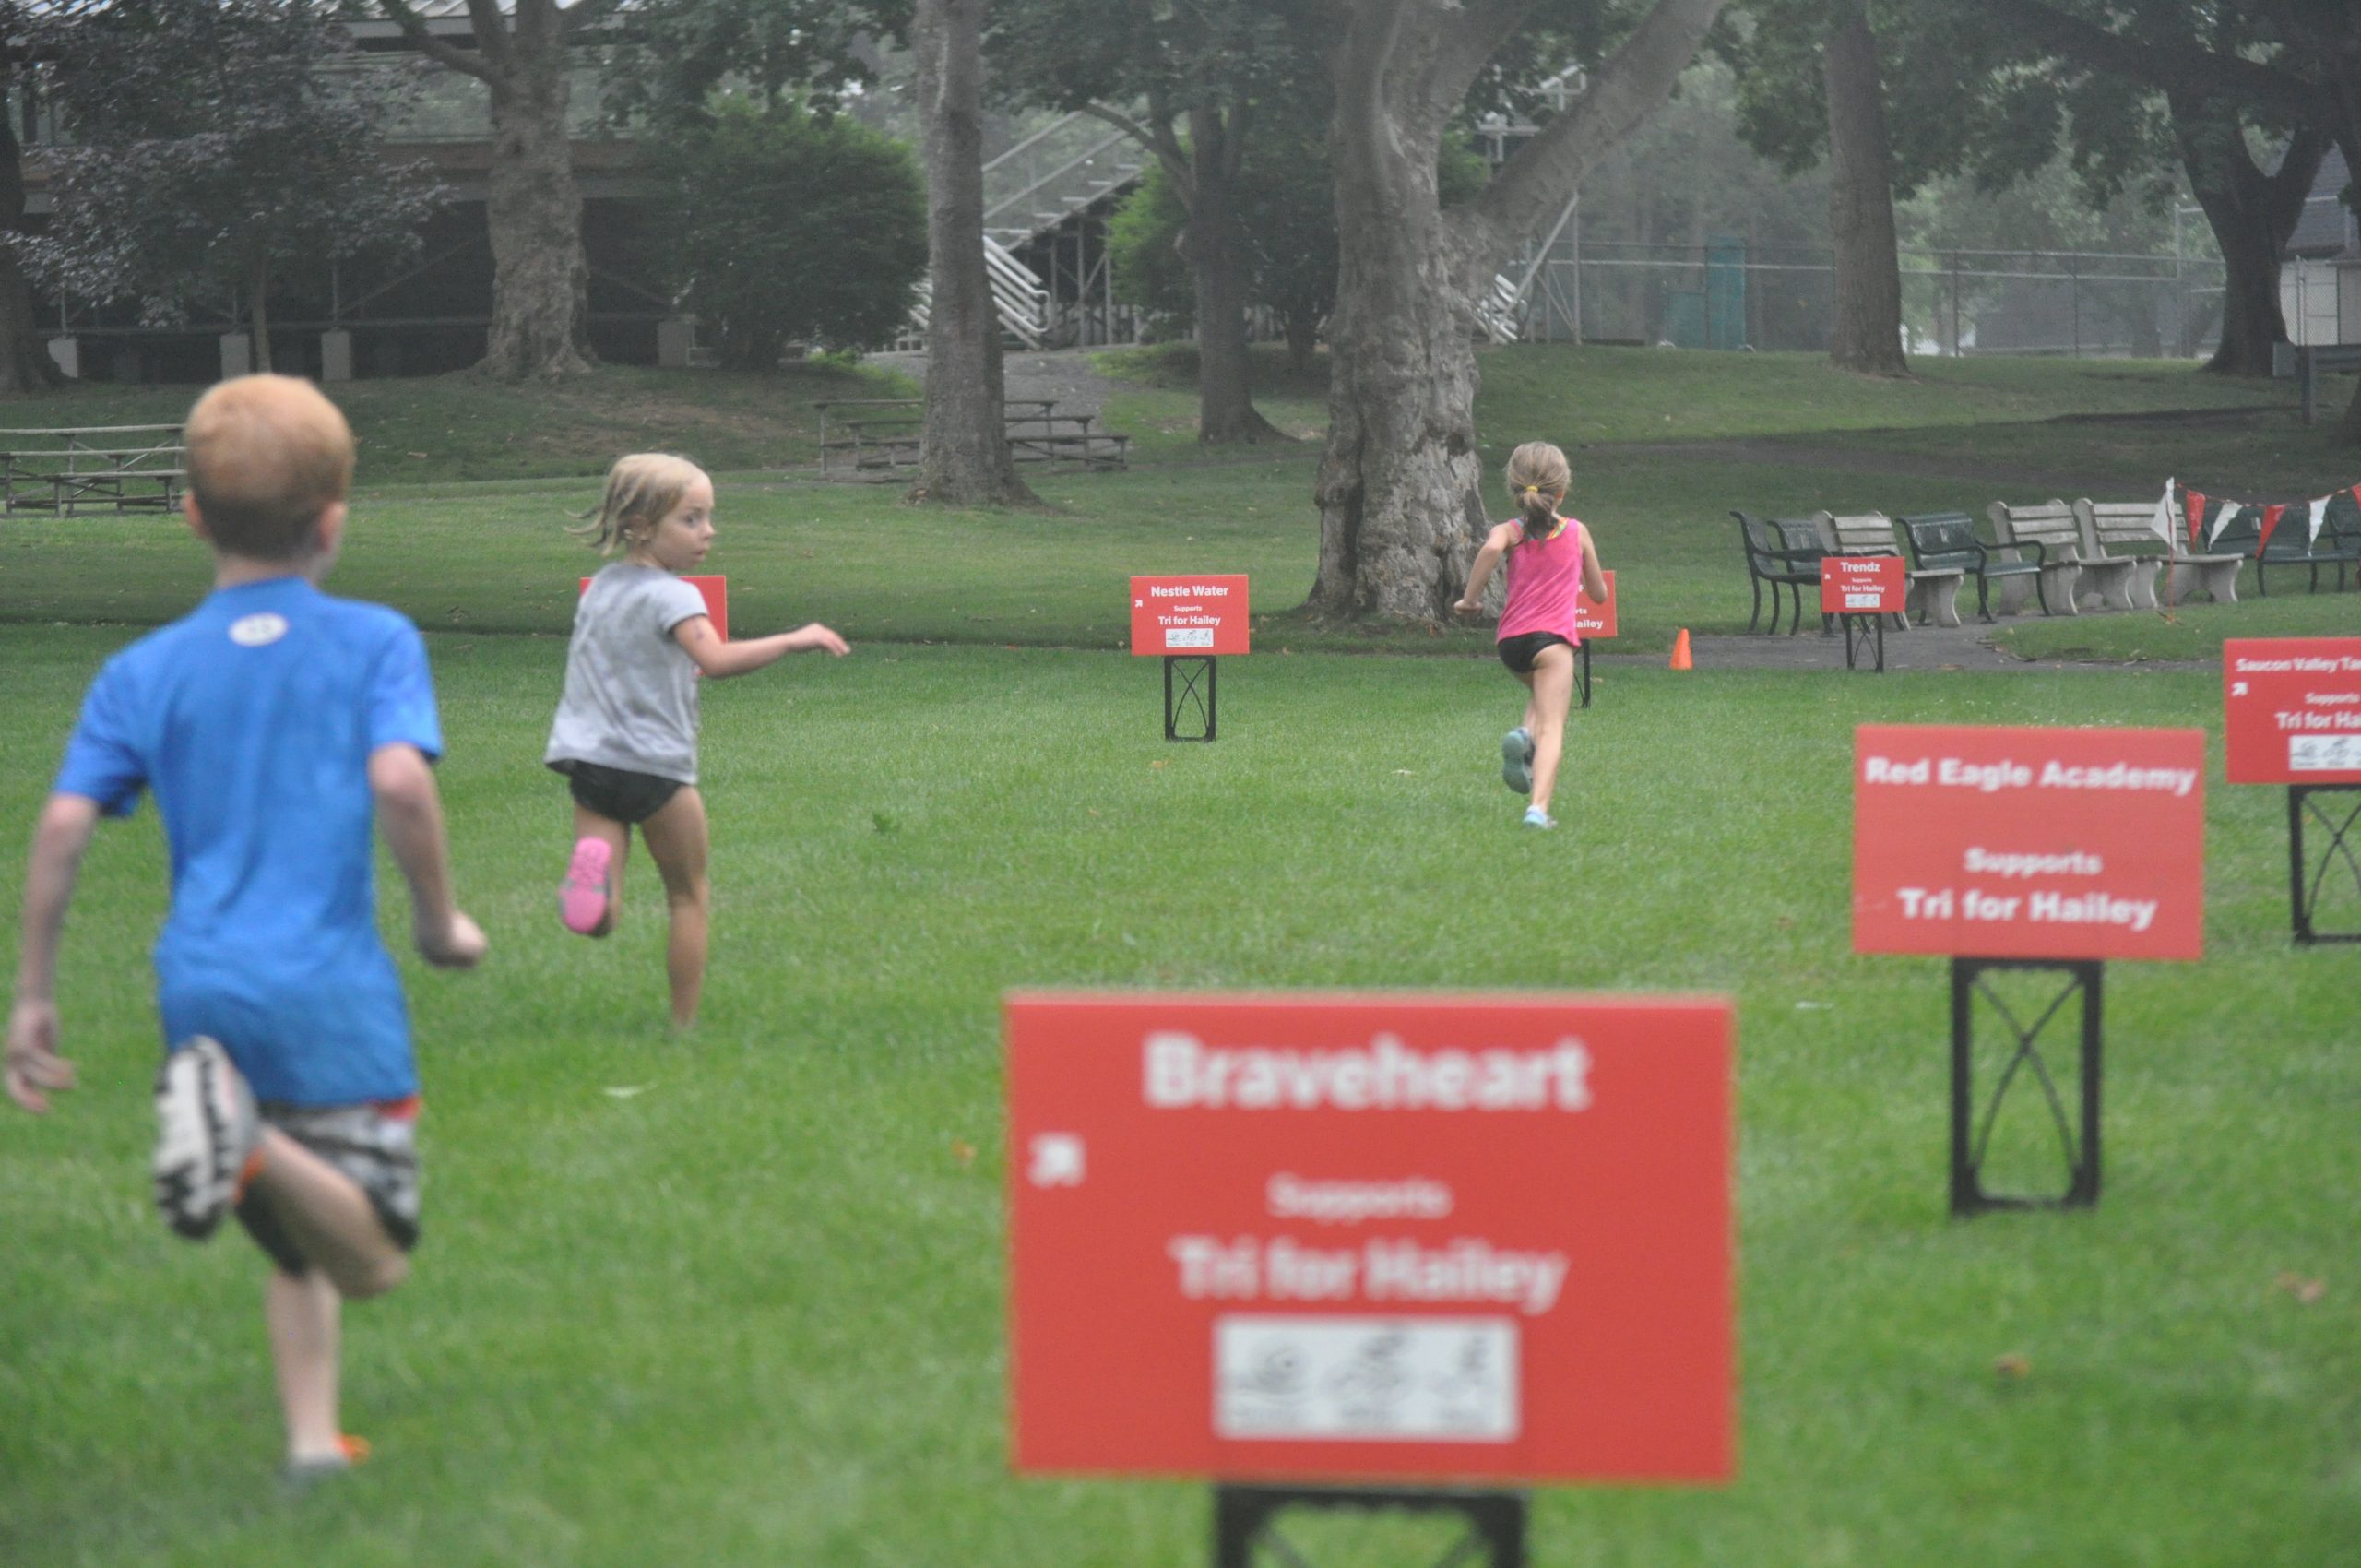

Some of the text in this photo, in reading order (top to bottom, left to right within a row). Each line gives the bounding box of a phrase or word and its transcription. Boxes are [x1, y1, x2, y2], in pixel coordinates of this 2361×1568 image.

[1840, 561, 1880, 572] Trendz
[1150, 585, 1228, 597] Nestle Water
[1173, 605, 1203, 613] Supports
[1158, 615, 1221, 626] Tri for Hailey
[2293, 657, 2338, 673] Valley
[2306, 693, 2360, 705] Supports
[2275, 711, 2302, 729] Tri
[2305, 711, 2332, 729] for
[1865, 756, 2197, 796] Red Eagle Academy
[1964, 847, 2103, 877] Supports
[1897, 888, 2157, 932] Tri for Hailey
[1143, 1031, 1591, 1111] Braveheart
[1169, 1236, 1567, 1315] Tri for Hailey
